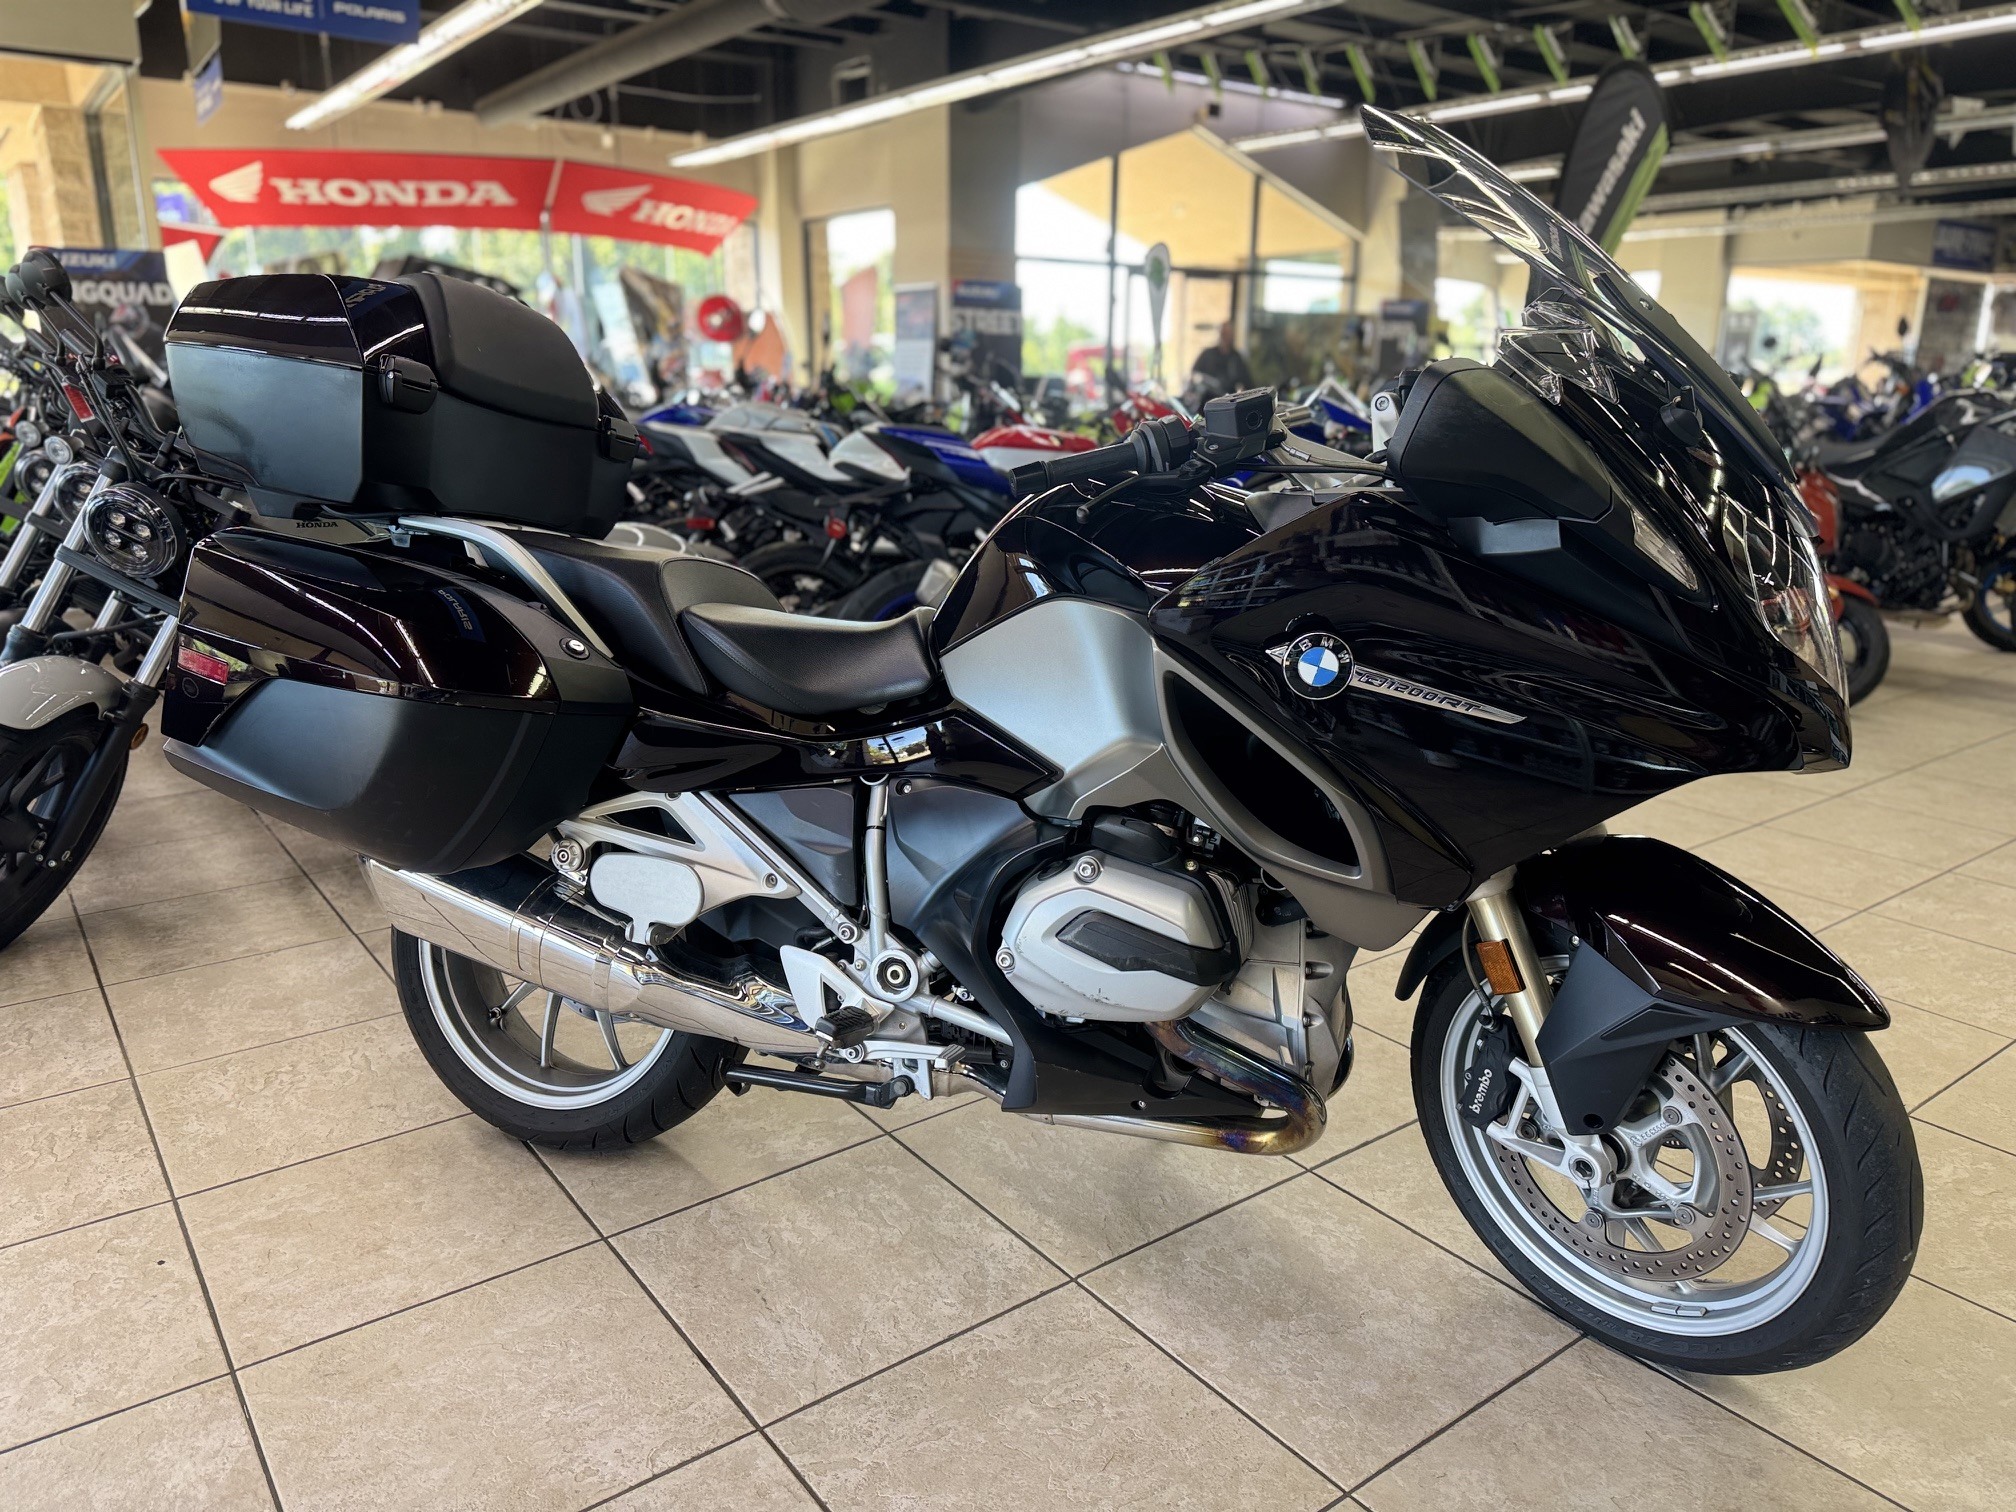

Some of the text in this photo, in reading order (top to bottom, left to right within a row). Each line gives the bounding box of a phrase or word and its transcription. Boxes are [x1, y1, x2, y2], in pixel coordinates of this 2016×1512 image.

[333, 1, 407, 25] POLARIS
[1574, 106, 1647, 235] awasaki
[269, 177, 518, 207] HONDA
[53, 251, 117, 270] UZUKI
[296, 521, 339, 529] HONDA
[1298, 636, 1351, 664] BMW
[1468, 1068, 1493, 1115] brembo
